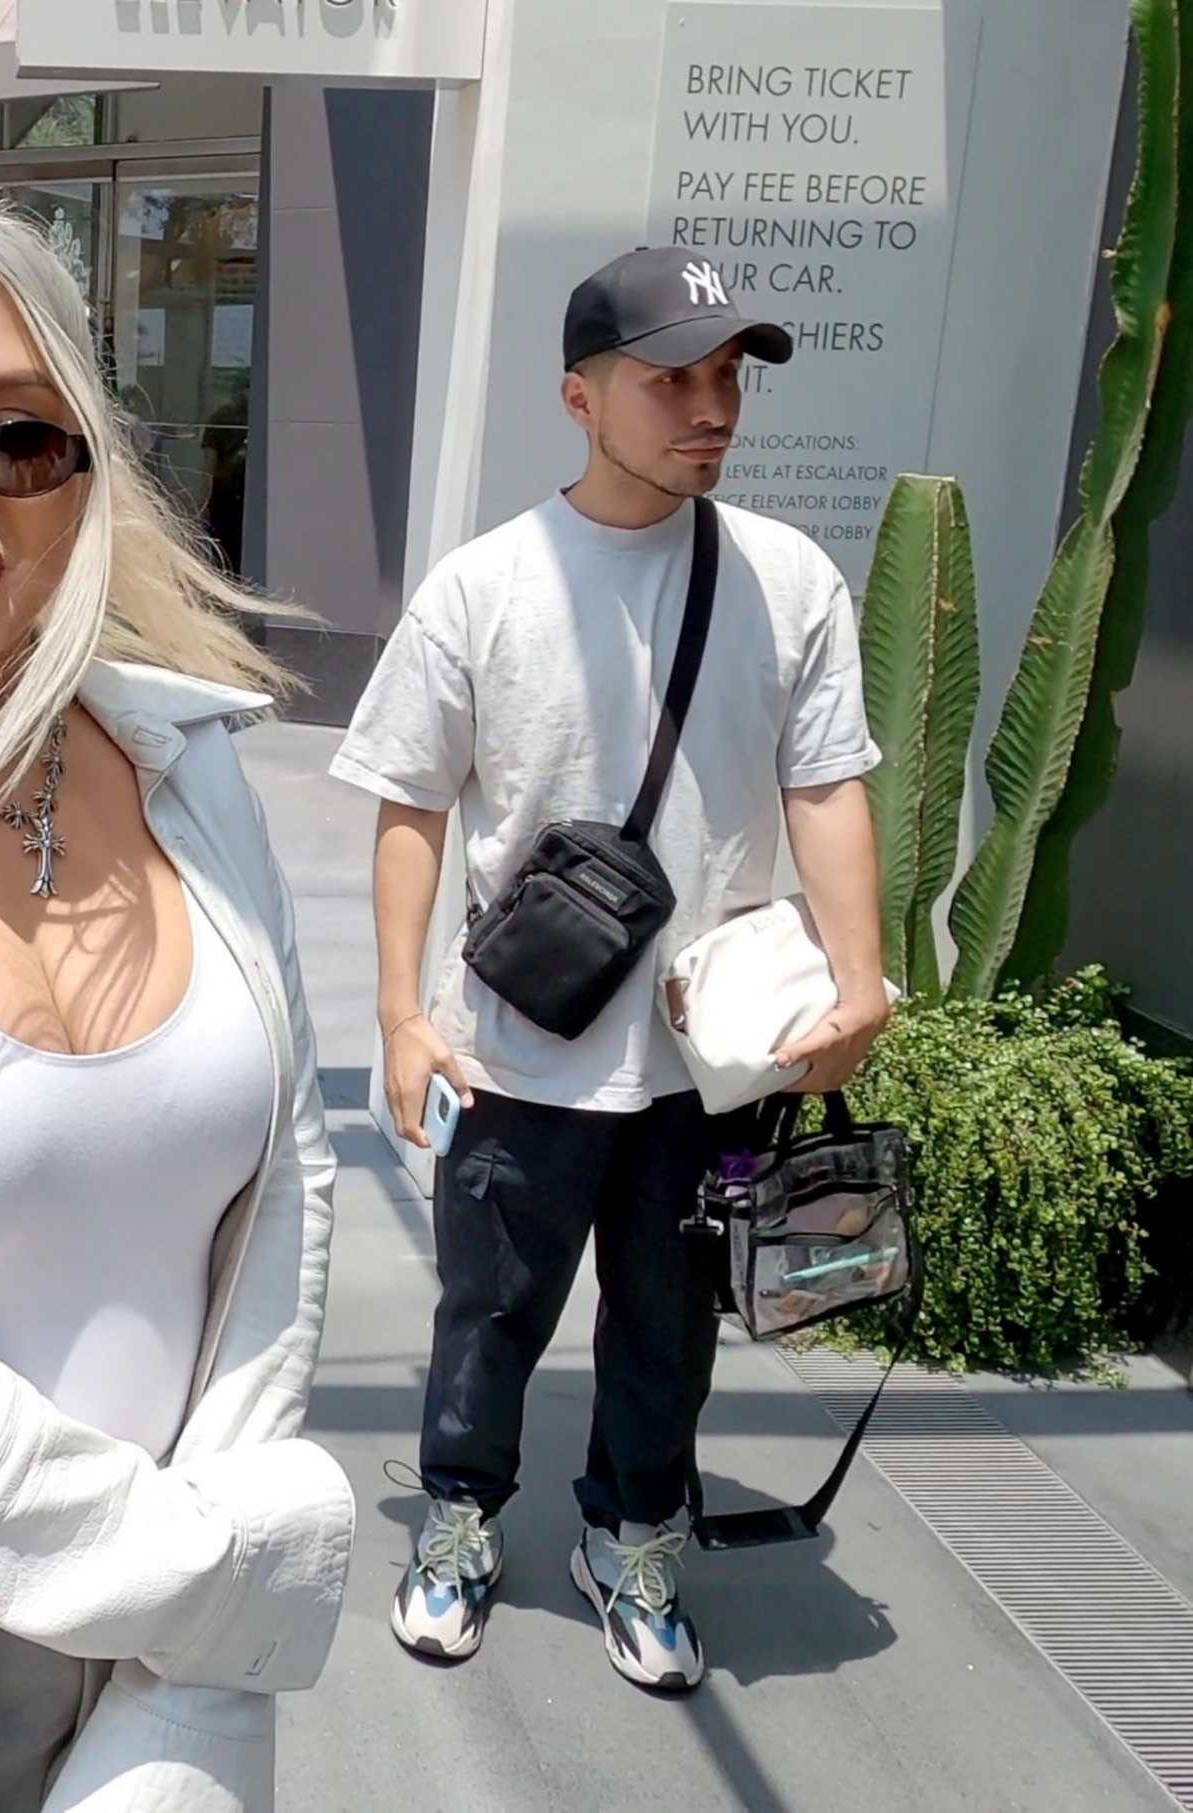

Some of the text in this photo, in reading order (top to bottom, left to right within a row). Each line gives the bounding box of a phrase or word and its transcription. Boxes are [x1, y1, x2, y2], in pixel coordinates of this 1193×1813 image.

[687, 64, 912, 99] BRING TICKET
[684, 111, 859, 144] WITH YOU.
[677, 171, 926, 205] PAY FEE BEFORE
[673, 216, 917, 250] RETURNING TO
[681, 261, 730, 305] NY
[719, 262, 842, 293] UR CAR.
[782, 322, 885, 351] HIERS
[726, 464, 887, 481] LEVEL AT ESCALATOR
[751, 494, 828, 510] ELEVATOR
[832, 496, 882, 511] LOBBY
[824, 524, 873, 540] LOBBY
